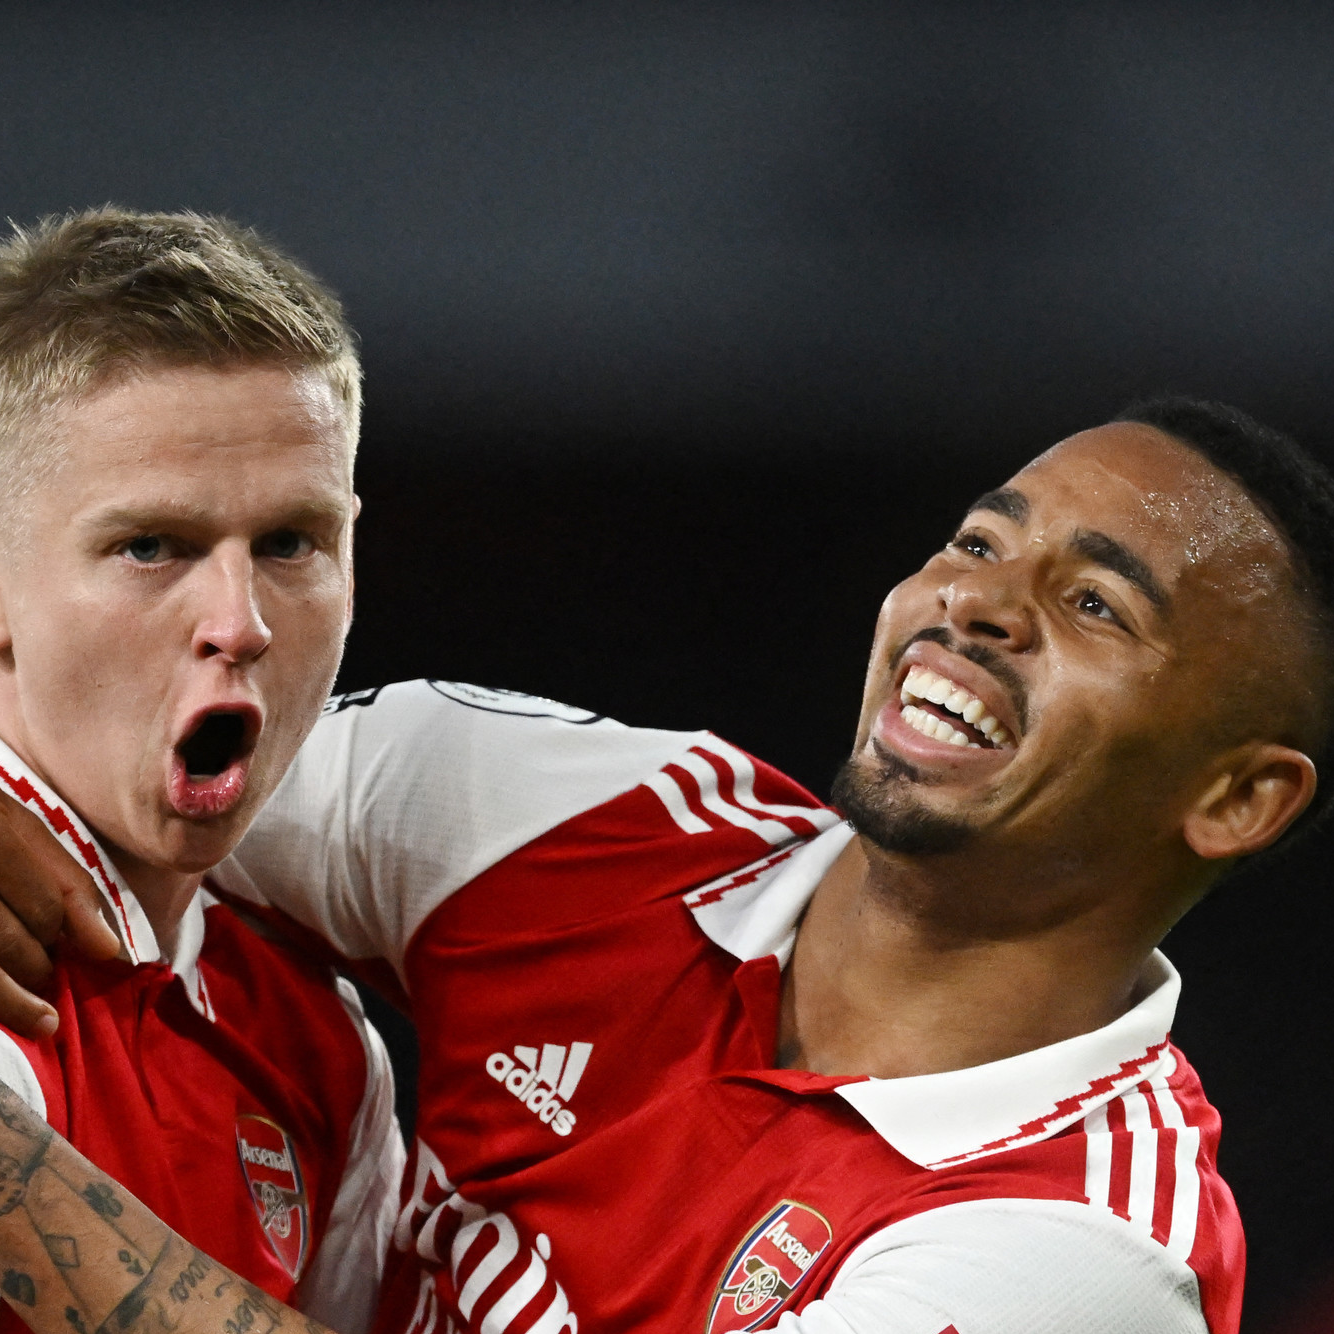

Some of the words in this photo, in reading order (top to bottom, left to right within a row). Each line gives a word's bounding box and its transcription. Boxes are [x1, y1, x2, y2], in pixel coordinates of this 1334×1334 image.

[486, 1052, 577, 1136] adidas
[241, 1137, 292, 1172] Arsenal
[764, 1220, 819, 1273] Arsenal
